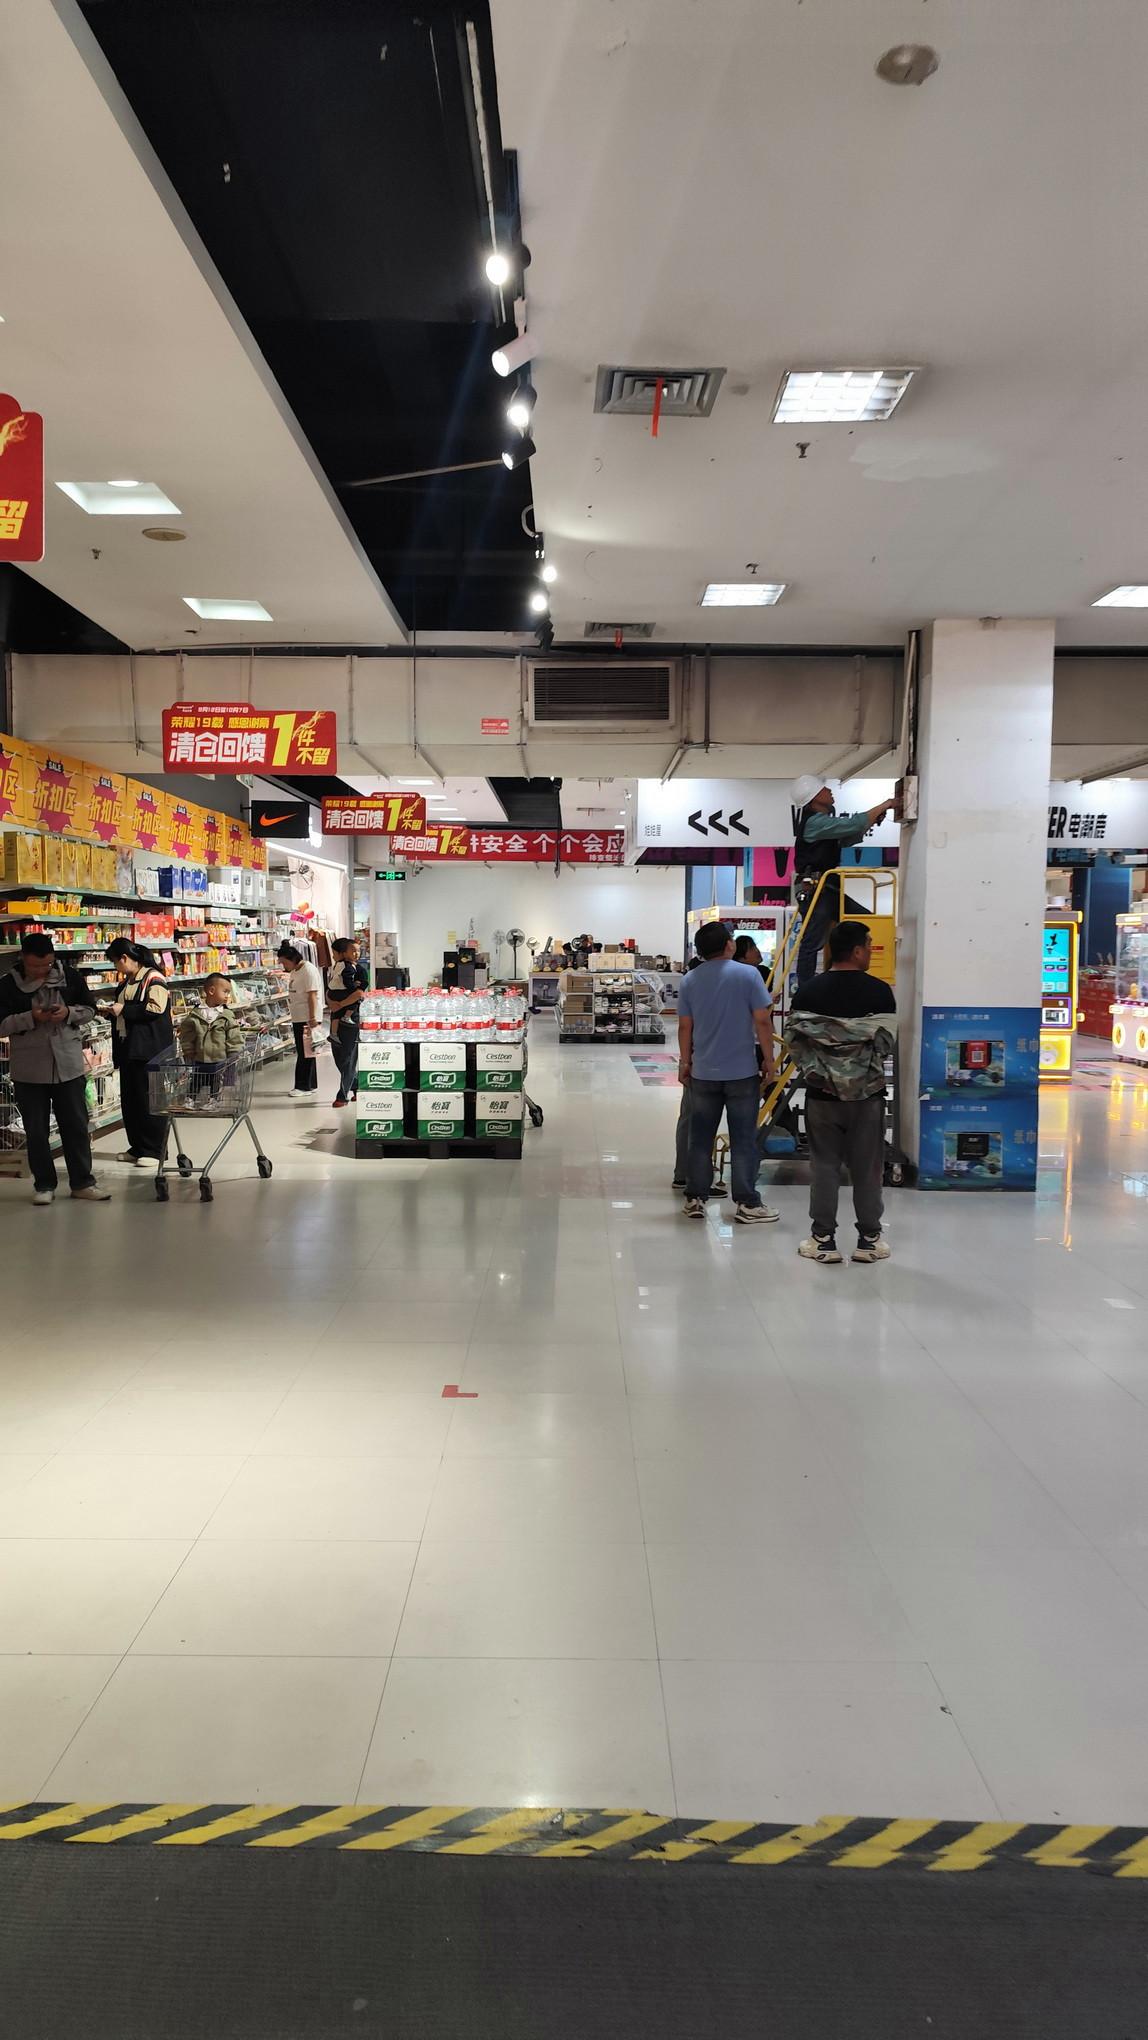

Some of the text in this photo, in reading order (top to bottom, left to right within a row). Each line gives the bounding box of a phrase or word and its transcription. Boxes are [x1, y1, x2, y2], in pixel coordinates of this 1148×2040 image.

[169, 713, 296, 766] 清仓回馈 1
[48, 761, 61, 772] SALE
[296, 747, 330, 765] 不留
[0, 767, 18, 800] 区
[33, 780, 76, 815] 折扣区
[88, 794, 121, 825] 折扣区
[132, 808, 160, 837] 折扣区
[325, 810, 384, 829] 清仓回馈
[1048, 806, 1067, 838] ER
[392, 835, 438, 852] 清仓回馈
